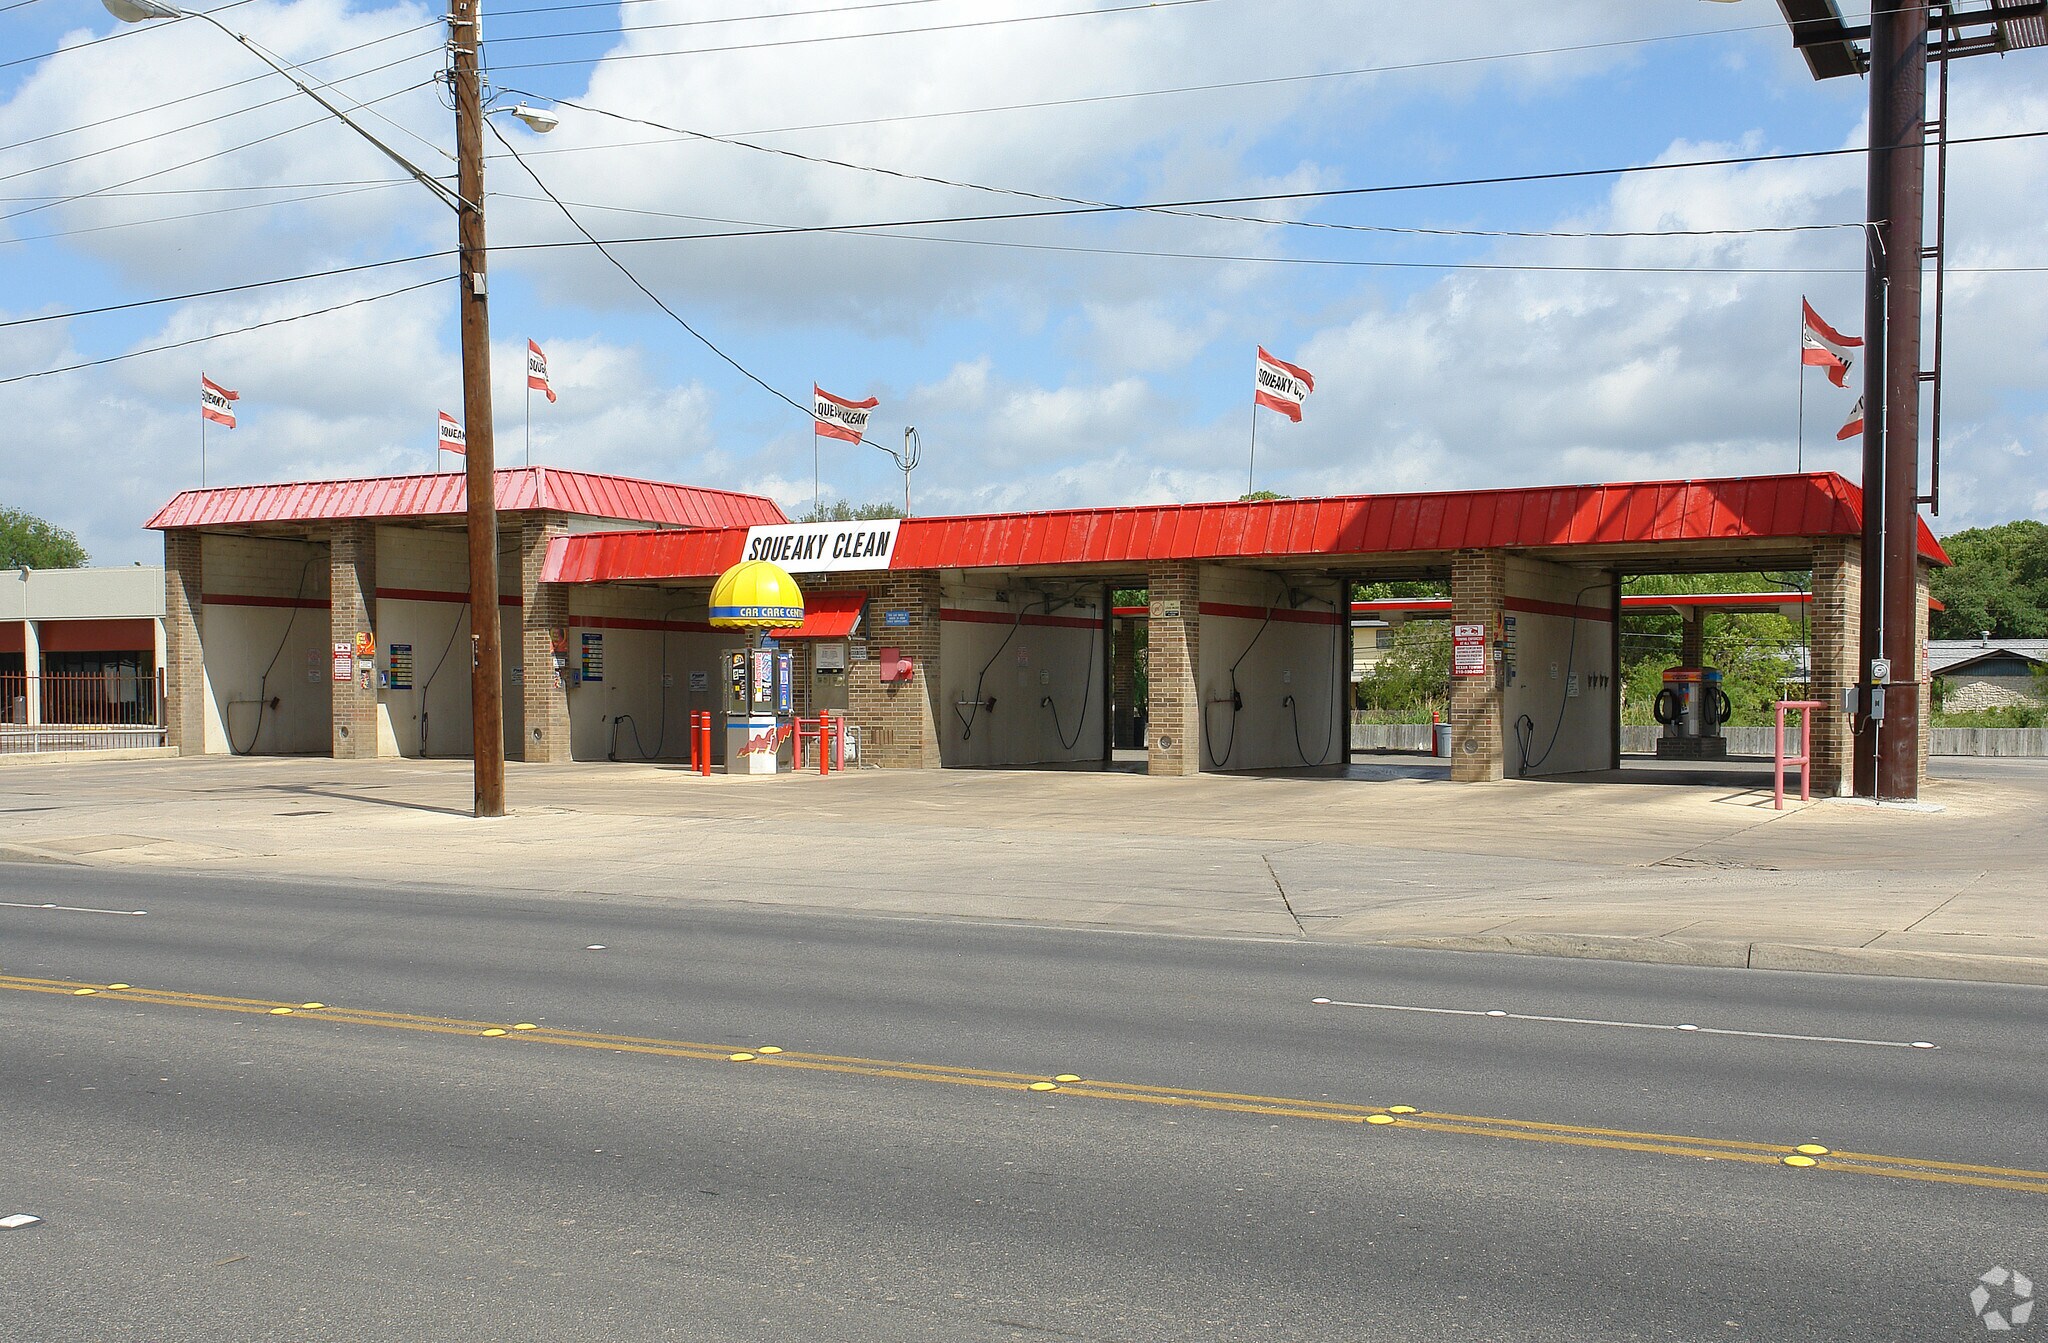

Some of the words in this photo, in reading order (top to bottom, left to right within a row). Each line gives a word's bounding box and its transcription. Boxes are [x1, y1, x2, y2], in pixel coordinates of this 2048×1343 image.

[1258, 368, 1293, 394] SQUEAKY
[842, 408, 868, 425] CLEAN
[748, 534, 829, 562] SQUEAKY
[832, 530, 891, 559] CLEAN
[740, 607, 759, 617] CAR
[761, 607, 785, 618] CARE
